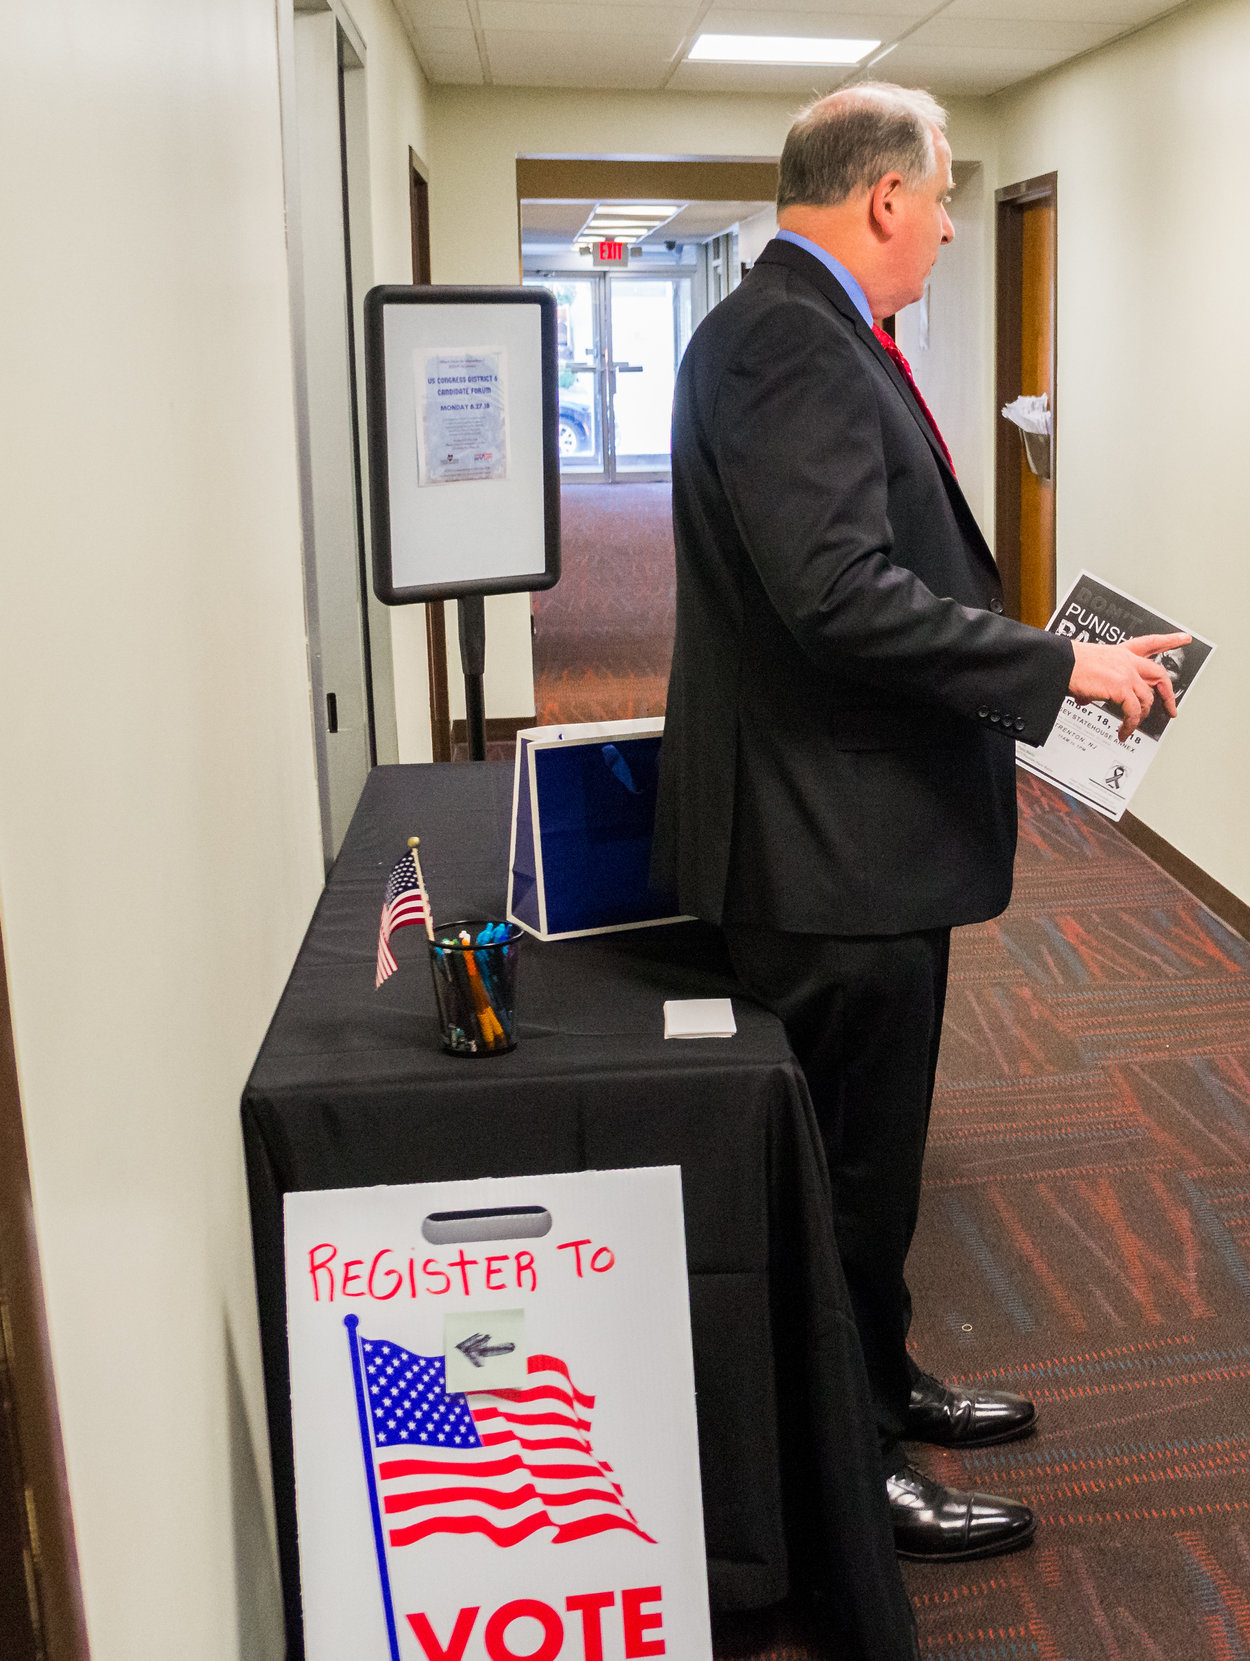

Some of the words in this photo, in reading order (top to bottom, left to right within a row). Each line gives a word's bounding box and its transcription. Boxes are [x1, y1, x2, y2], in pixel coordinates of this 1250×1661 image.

[599, 241, 624, 261] EXIT
[427, 377, 436, 385] US
[437, 376, 466, 385] CONGRESS
[467, 375, 493, 383] DISTRICT
[437, 388, 470, 396] CANDIDATE
[470, 387, 492, 395] FORUM
[440, 404, 469, 412] MONDAY
[1065, 602, 1134, 645] PUNISH
[1097, 715, 1111, 729] 18,
[1072, 714, 1113, 739] STATEHOUSE
[1113, 736, 1136, 753] ANNEX
[1088, 742, 1098, 750] NJ
[307, 1242, 538, 1303] REGISTER
[556, 1239, 616, 1278] TO
[405, 1585, 667, 1661] VOTE
